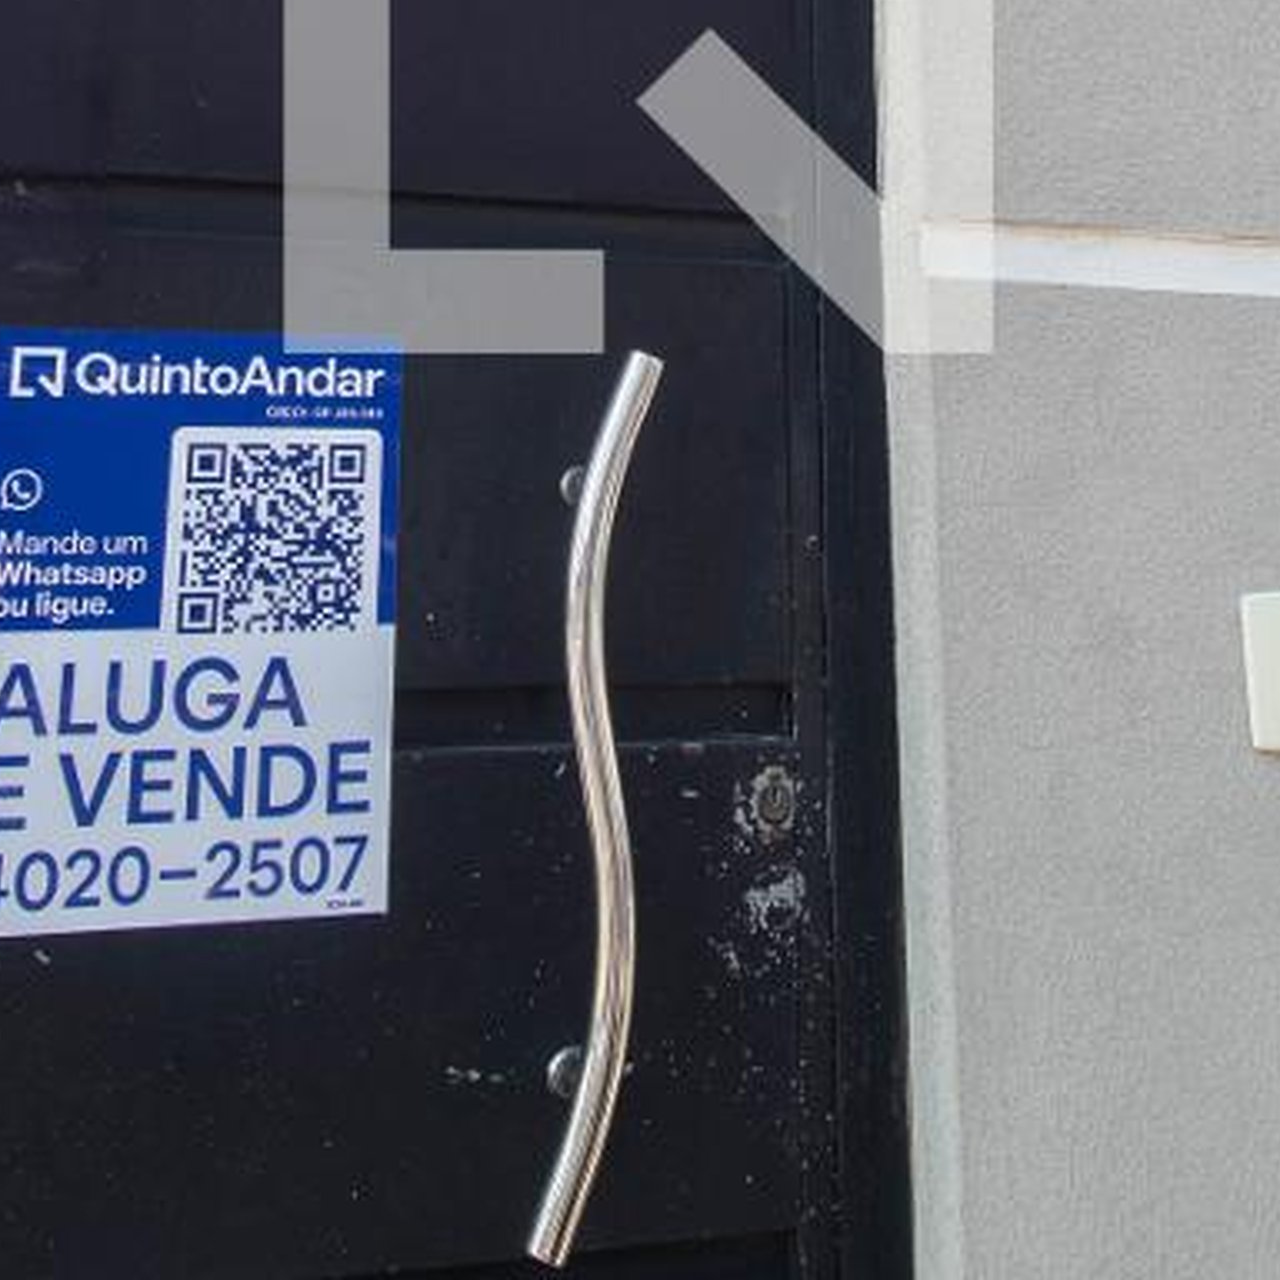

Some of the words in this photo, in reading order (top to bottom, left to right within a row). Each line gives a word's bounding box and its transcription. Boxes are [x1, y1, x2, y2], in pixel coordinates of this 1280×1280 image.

[75, 354, 386, 398] QuintoAndar
[102, 535, 148, 555] um
[35, 591, 115, 624] ligue.
[58, 740, 373, 828] VENDE
